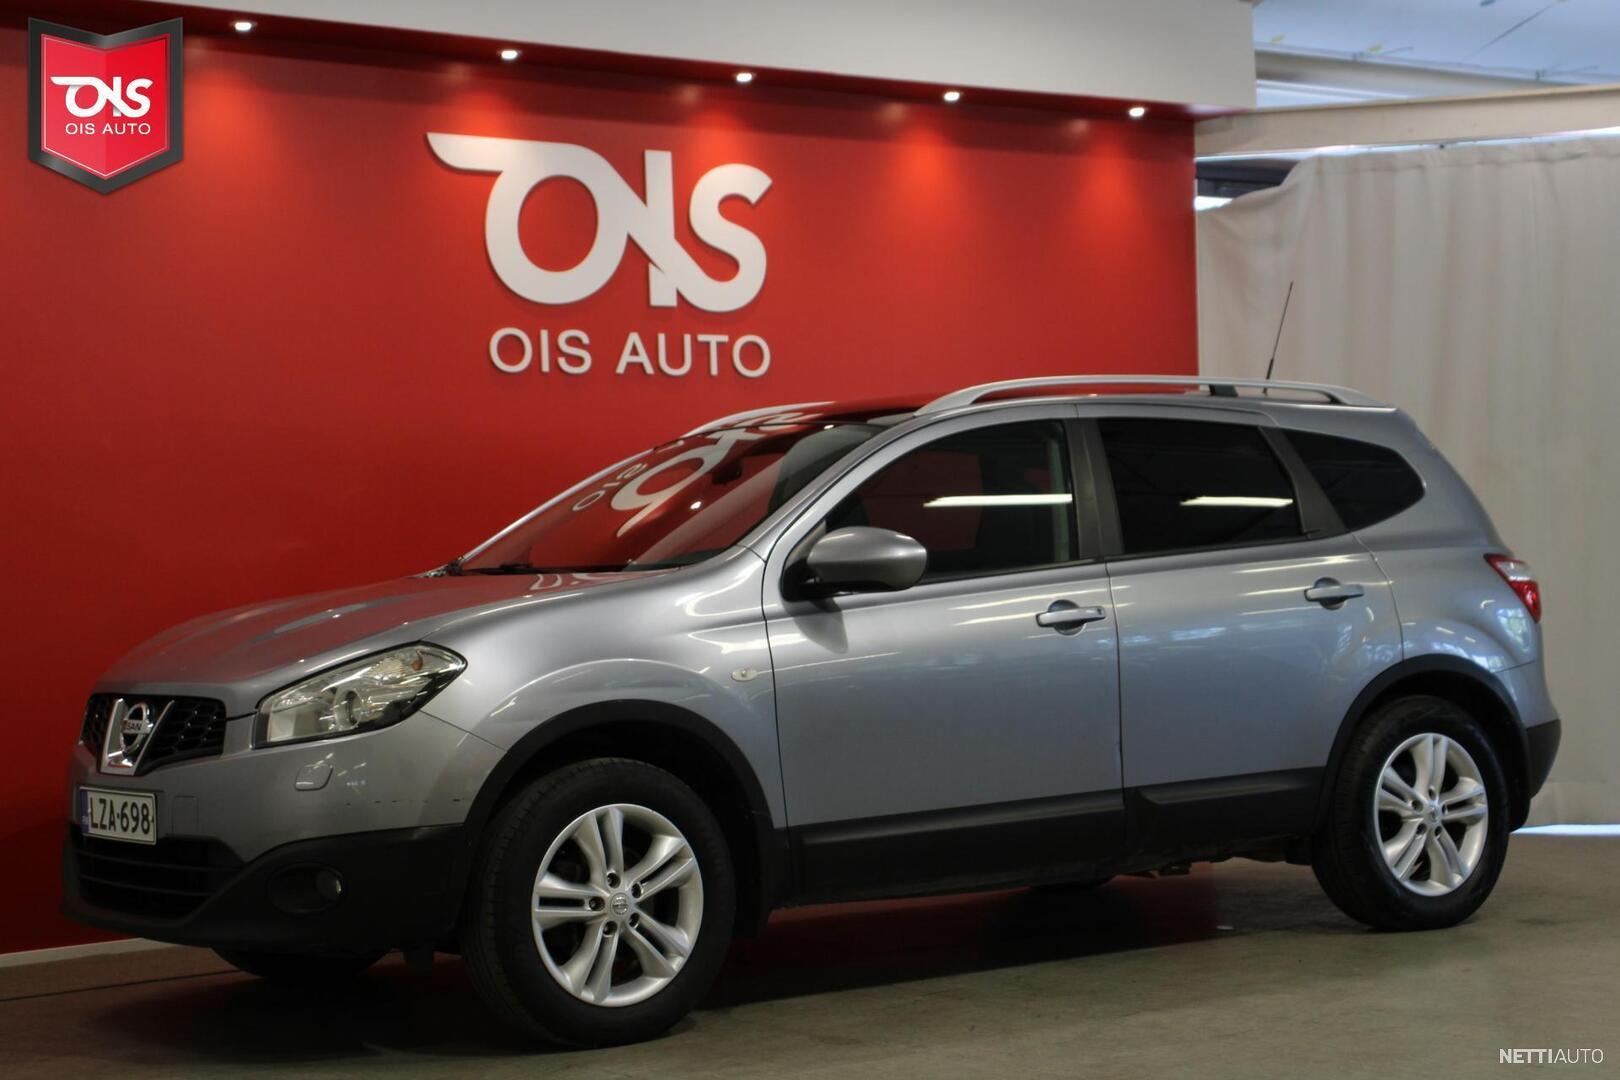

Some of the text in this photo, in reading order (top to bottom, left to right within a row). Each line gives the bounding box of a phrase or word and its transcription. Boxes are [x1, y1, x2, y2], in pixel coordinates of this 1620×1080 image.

[426, 132, 773, 313] OIS
[489, 327, 771, 378] OIS AUTO
